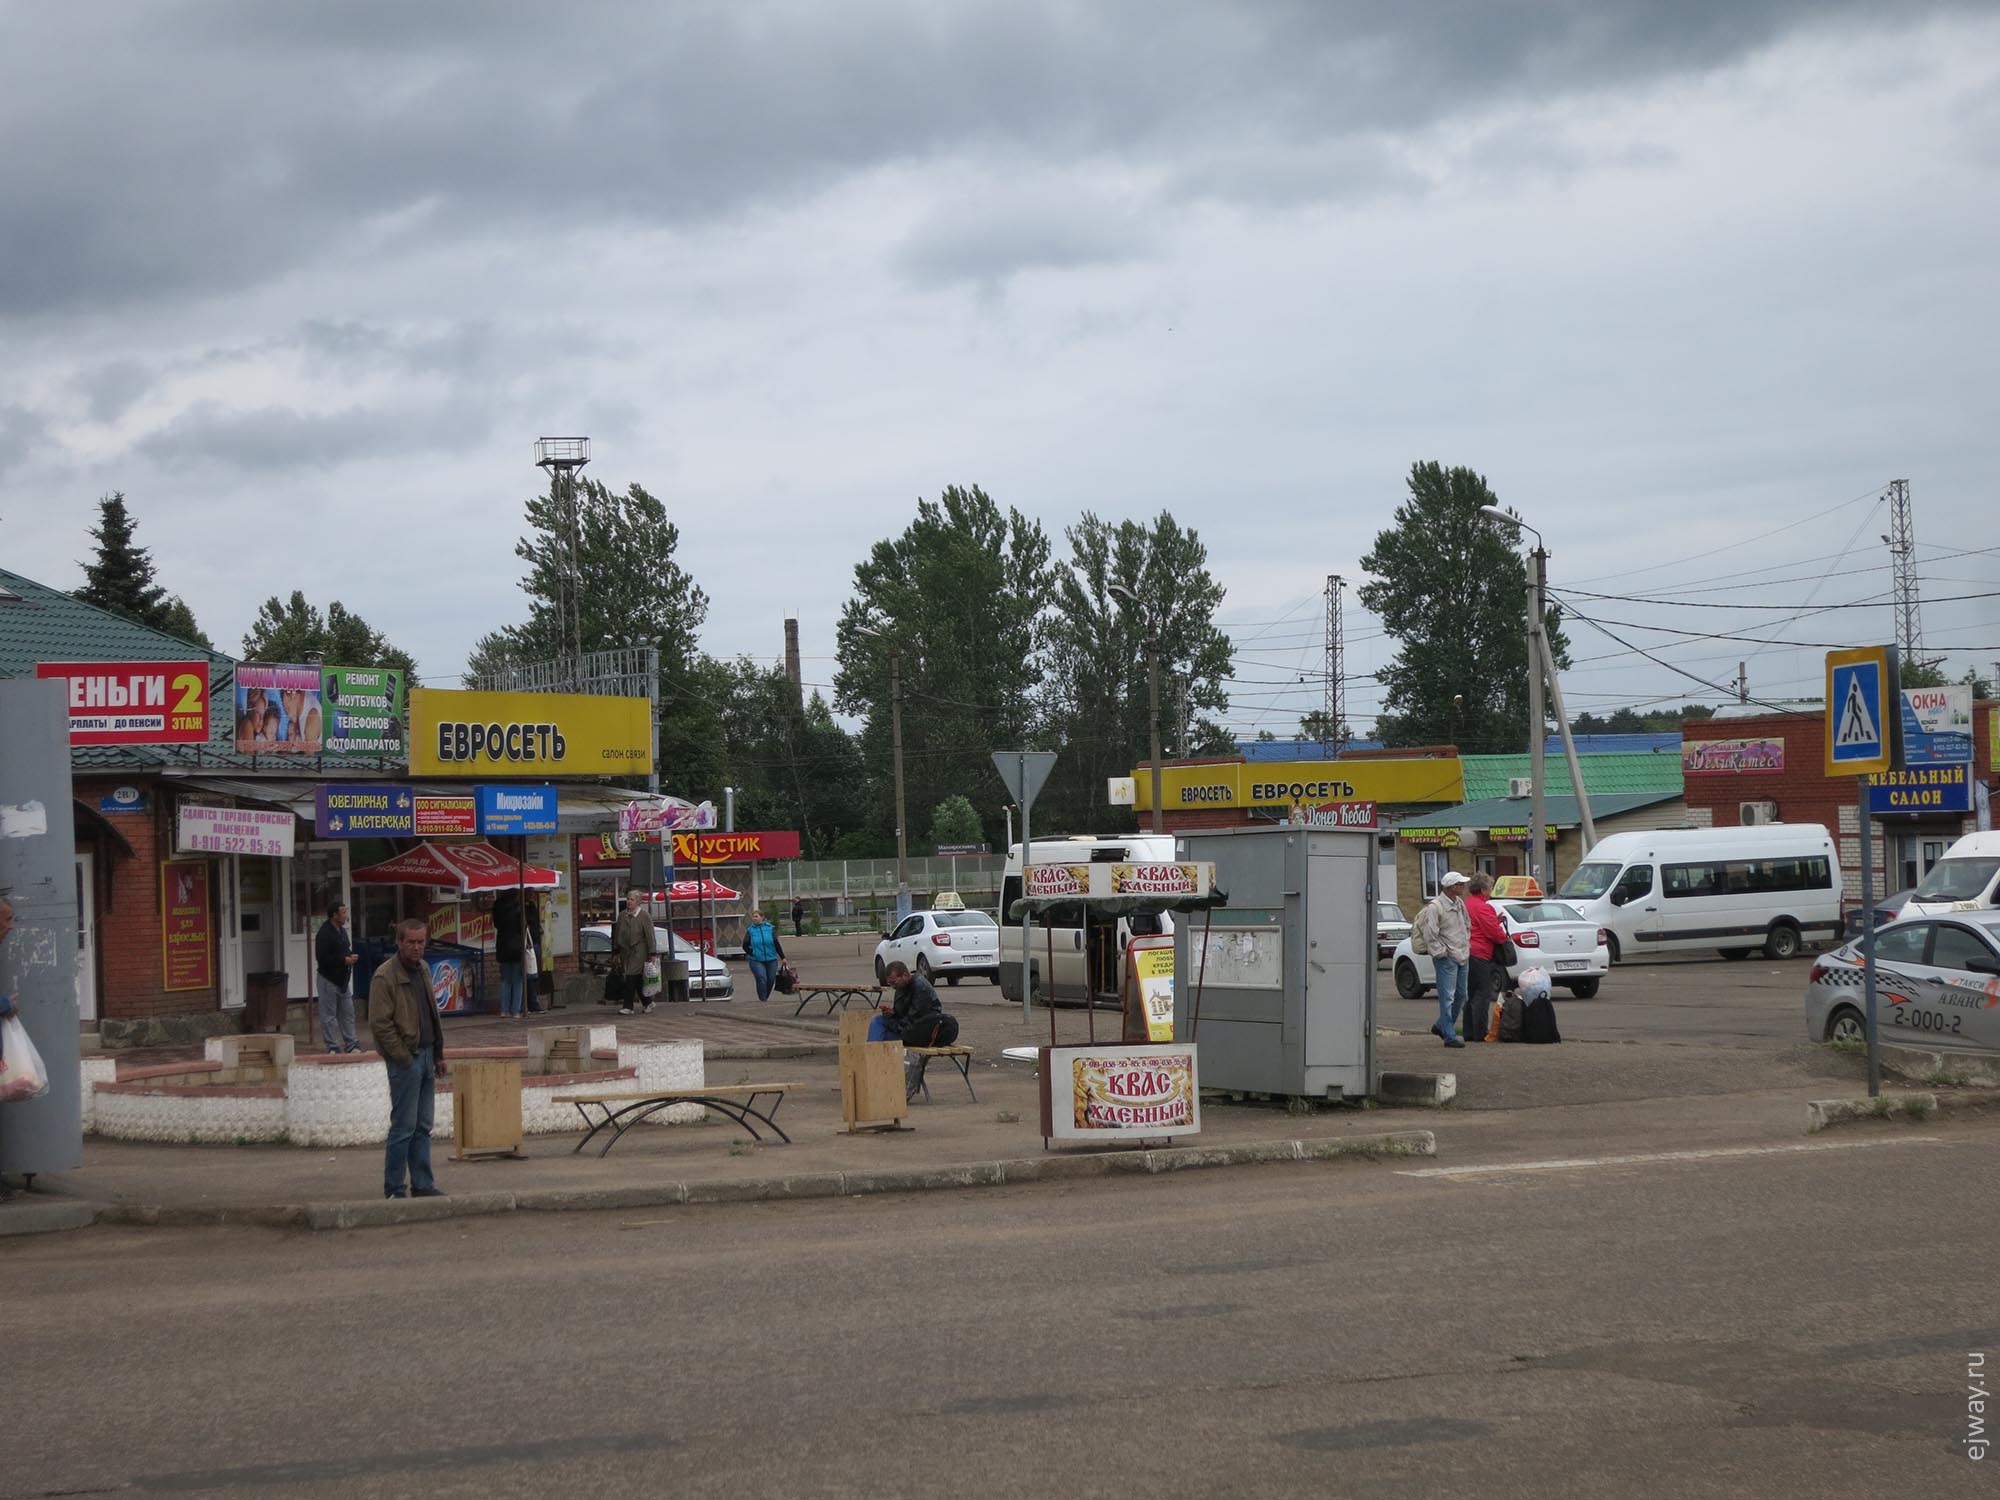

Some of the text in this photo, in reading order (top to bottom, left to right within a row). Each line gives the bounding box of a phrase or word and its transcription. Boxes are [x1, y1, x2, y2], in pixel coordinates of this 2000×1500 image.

[346, 672, 380, 686] РЕМОНТ
[54, 675, 166, 708] ЕНЬГИ
[171, 673, 203, 714] 2
[338, 694, 388, 709] НОУТБУКОВ
[1912, 692, 1946, 710] ОКНА
[115, 720, 127, 729] ДО
[129, 718, 162, 728] ПЕНСИИ
[172, 717, 203, 730] ЭТАЖ
[338, 716, 390, 730] ТЕЛЕФОНОВ
[326, 738, 401, 752] ФОТОАППАРАТОВ
[438, 722, 566, 762] ЕВРОСЕТЬ
[602, 748, 646, 760] салон связи
[1868, 765, 1964, 786] МЕБЕЛЬНЫЙ
[1180, 784, 1233, 803] ЕВРОСЕТЬ
[1251, 780, 1355, 802] ЕВРОСЕТЬ
[1890, 789, 1942, 806] САЛОН
[327, 794, 389, 810] ЮВЕЛИРНАЯ
[496, 792, 544, 812] Микрозайм
[183, 808, 292, 825] СДАЮТСЯ ТОРГОВО-ОФИСНЫЕ
[349, 815, 411, 831] МАСТЕРСКАЯ
[1307, 803, 1372, 826] Донер Кебаб
[212, 824, 260, 836] ПОМЕЩЕНИЯ
[192, 834, 281, 855] 8-910-522-95-35
[1033, 867, 1066, 883] КВАС
[1136, 866, 1181, 882] КВАС
[1123, 881, 1190, 892] ХЛЕБНЫЙ
[1895, 1007, 1961, 1033] 2-000-2
[1108, 1072, 1170, 1096] КВАС
[1090, 1099, 1185, 1123] ХЛЕБНЫЙ
